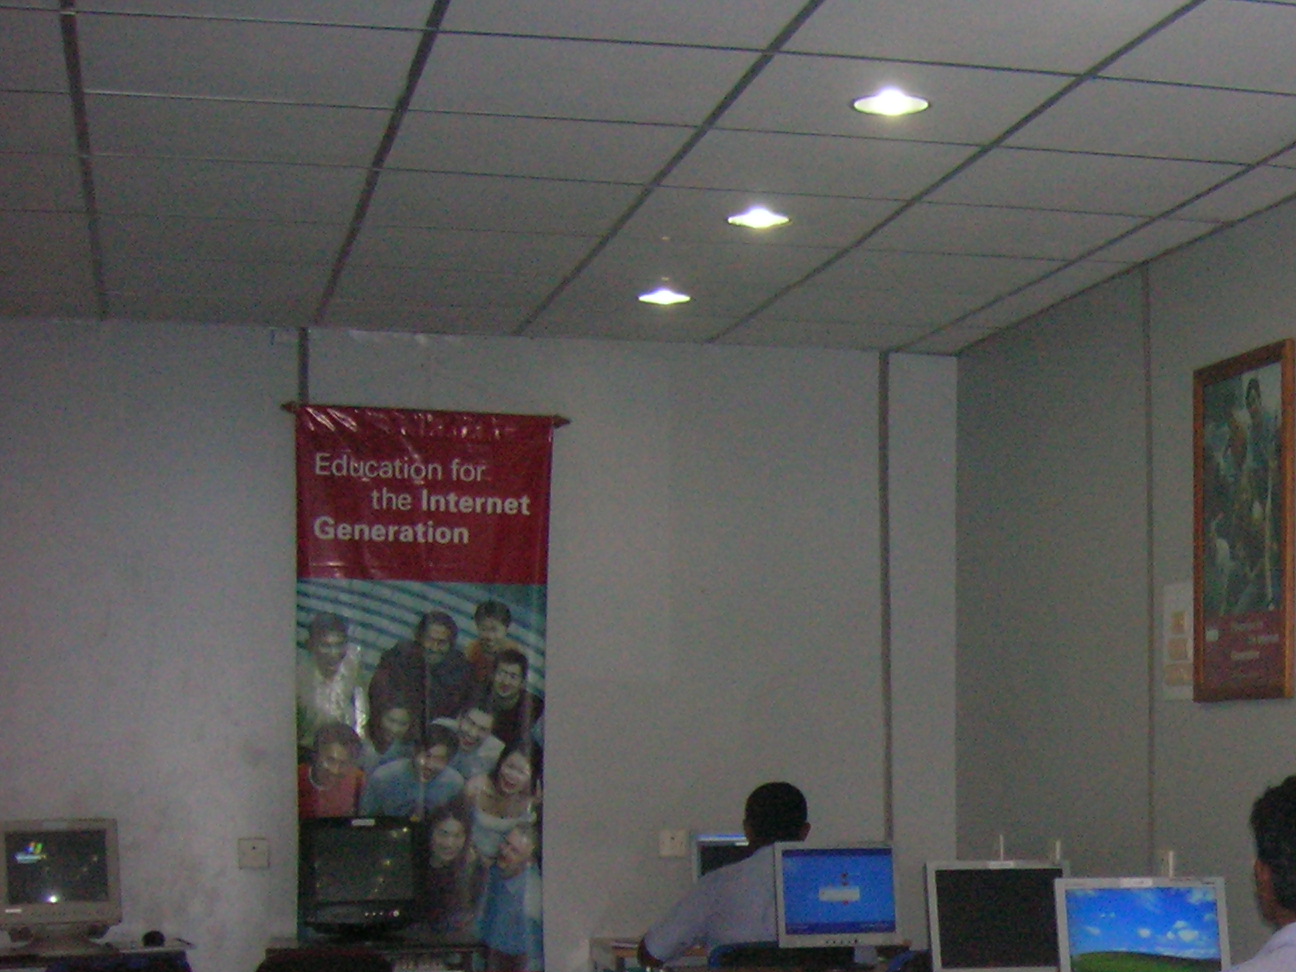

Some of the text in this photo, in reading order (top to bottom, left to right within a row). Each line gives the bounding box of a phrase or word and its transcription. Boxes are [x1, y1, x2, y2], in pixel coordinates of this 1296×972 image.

[315, 452, 487, 482] Education for
[371, 487, 531, 516] the Internet
[313, 515, 470, 545] Generation
